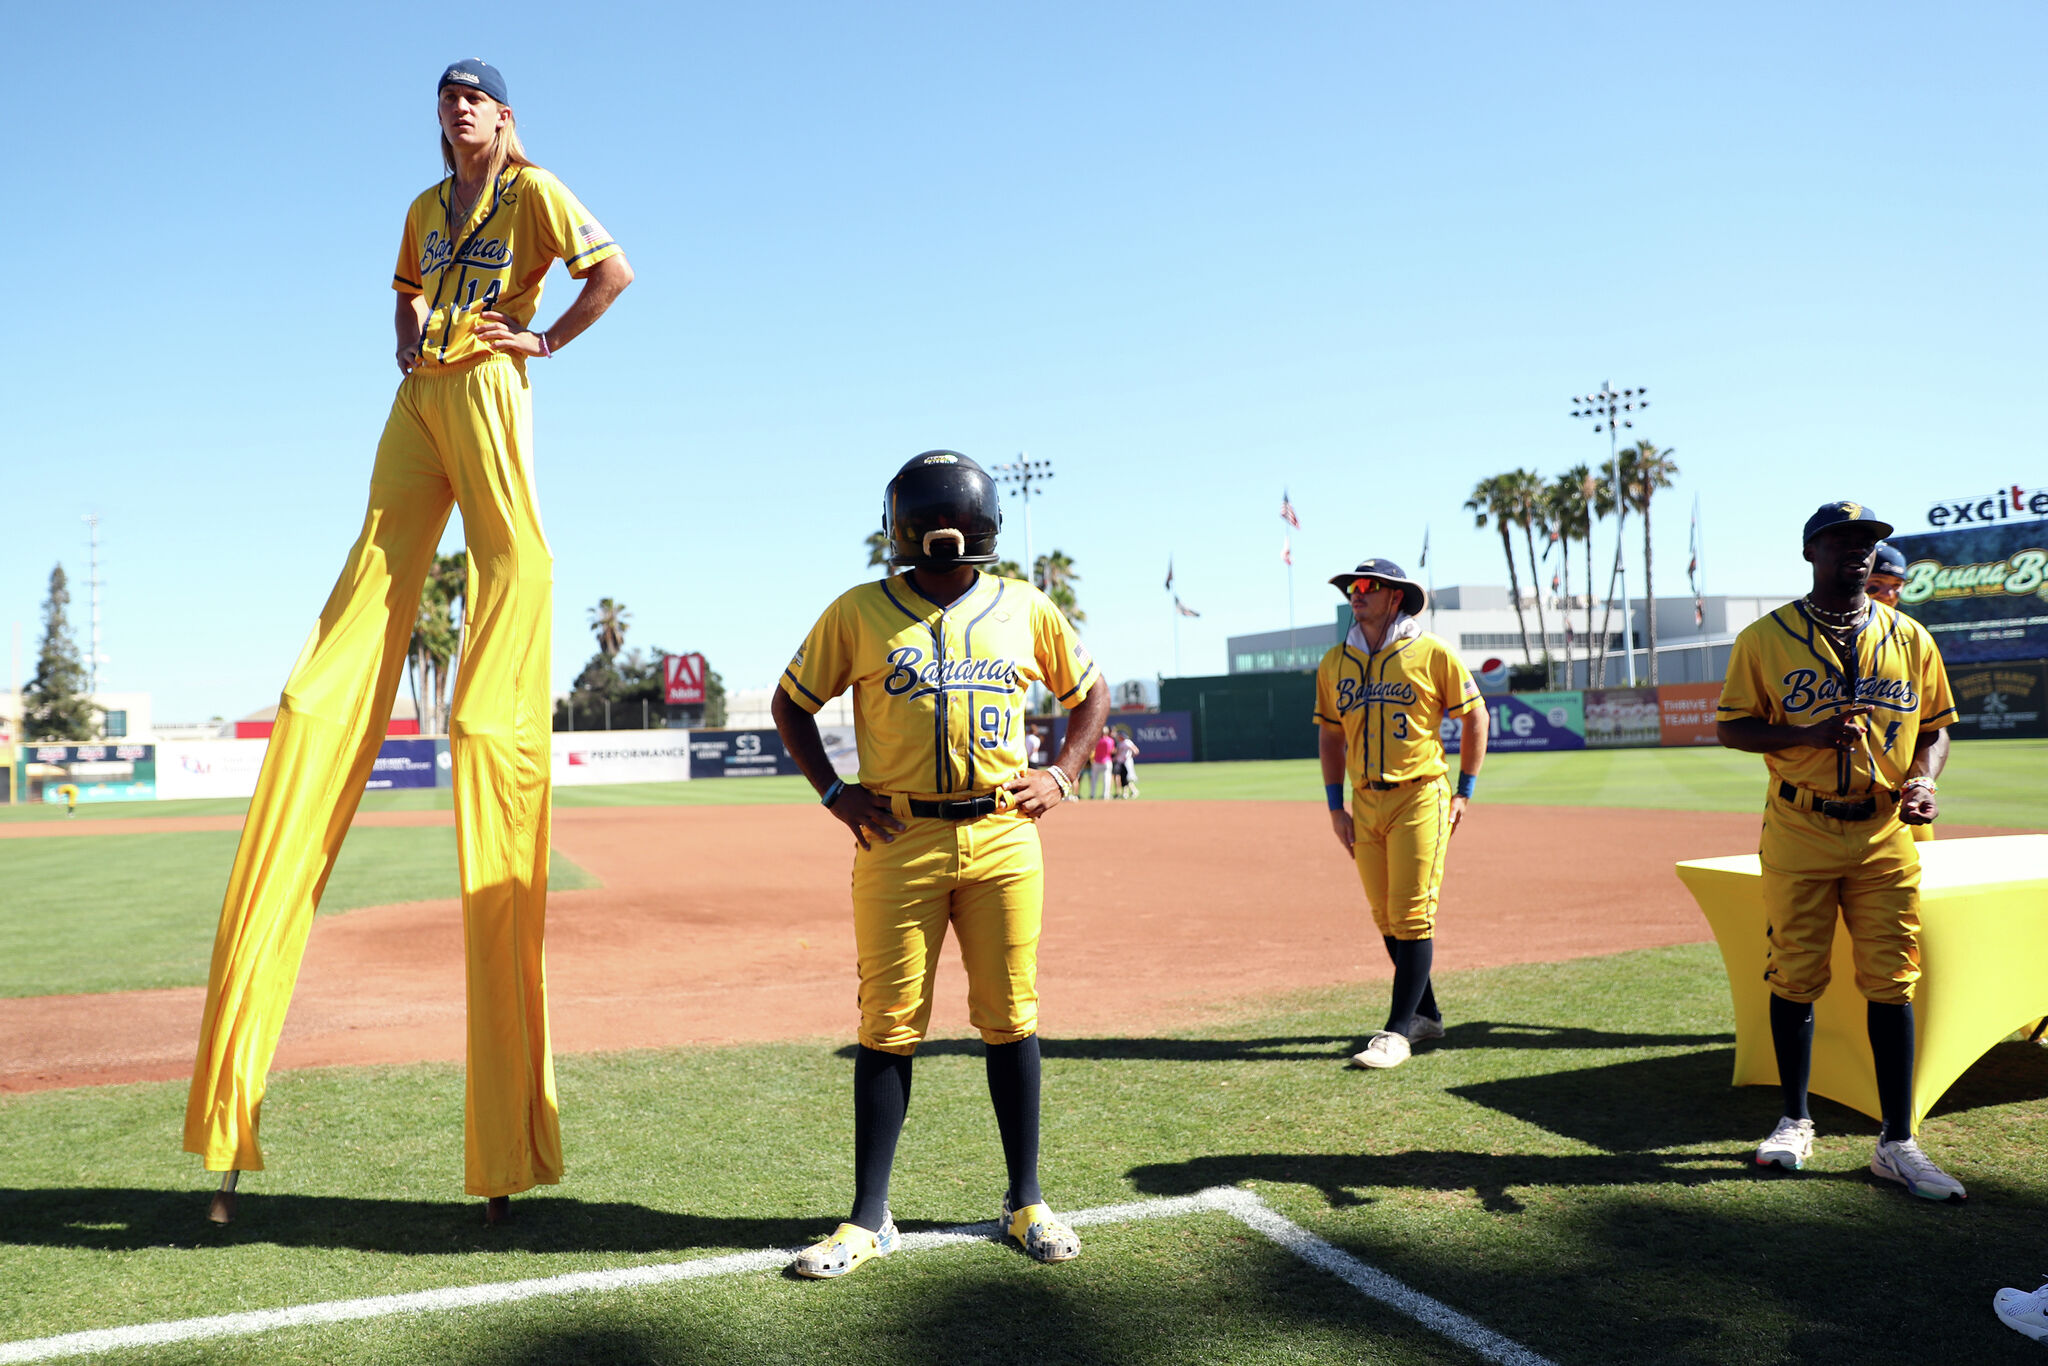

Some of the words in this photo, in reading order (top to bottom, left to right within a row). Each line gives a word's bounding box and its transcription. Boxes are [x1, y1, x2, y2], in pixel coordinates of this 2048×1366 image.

[461, 278, 503, 312] 14
[1928, 484, 2048, 527] excite
[1899, 560, 2008, 605] Banana
[884, 646, 1019, 702] Bananas
[1336, 678, 1417, 713] Bananas
[1663, 699, 1707, 711] THRIVE
[978, 706, 1011, 749] 91
[1392, 712, 1408, 739] 3
[1664, 713, 1699, 727] TEAM
[591, 747, 685, 760] PERFORMANCE
